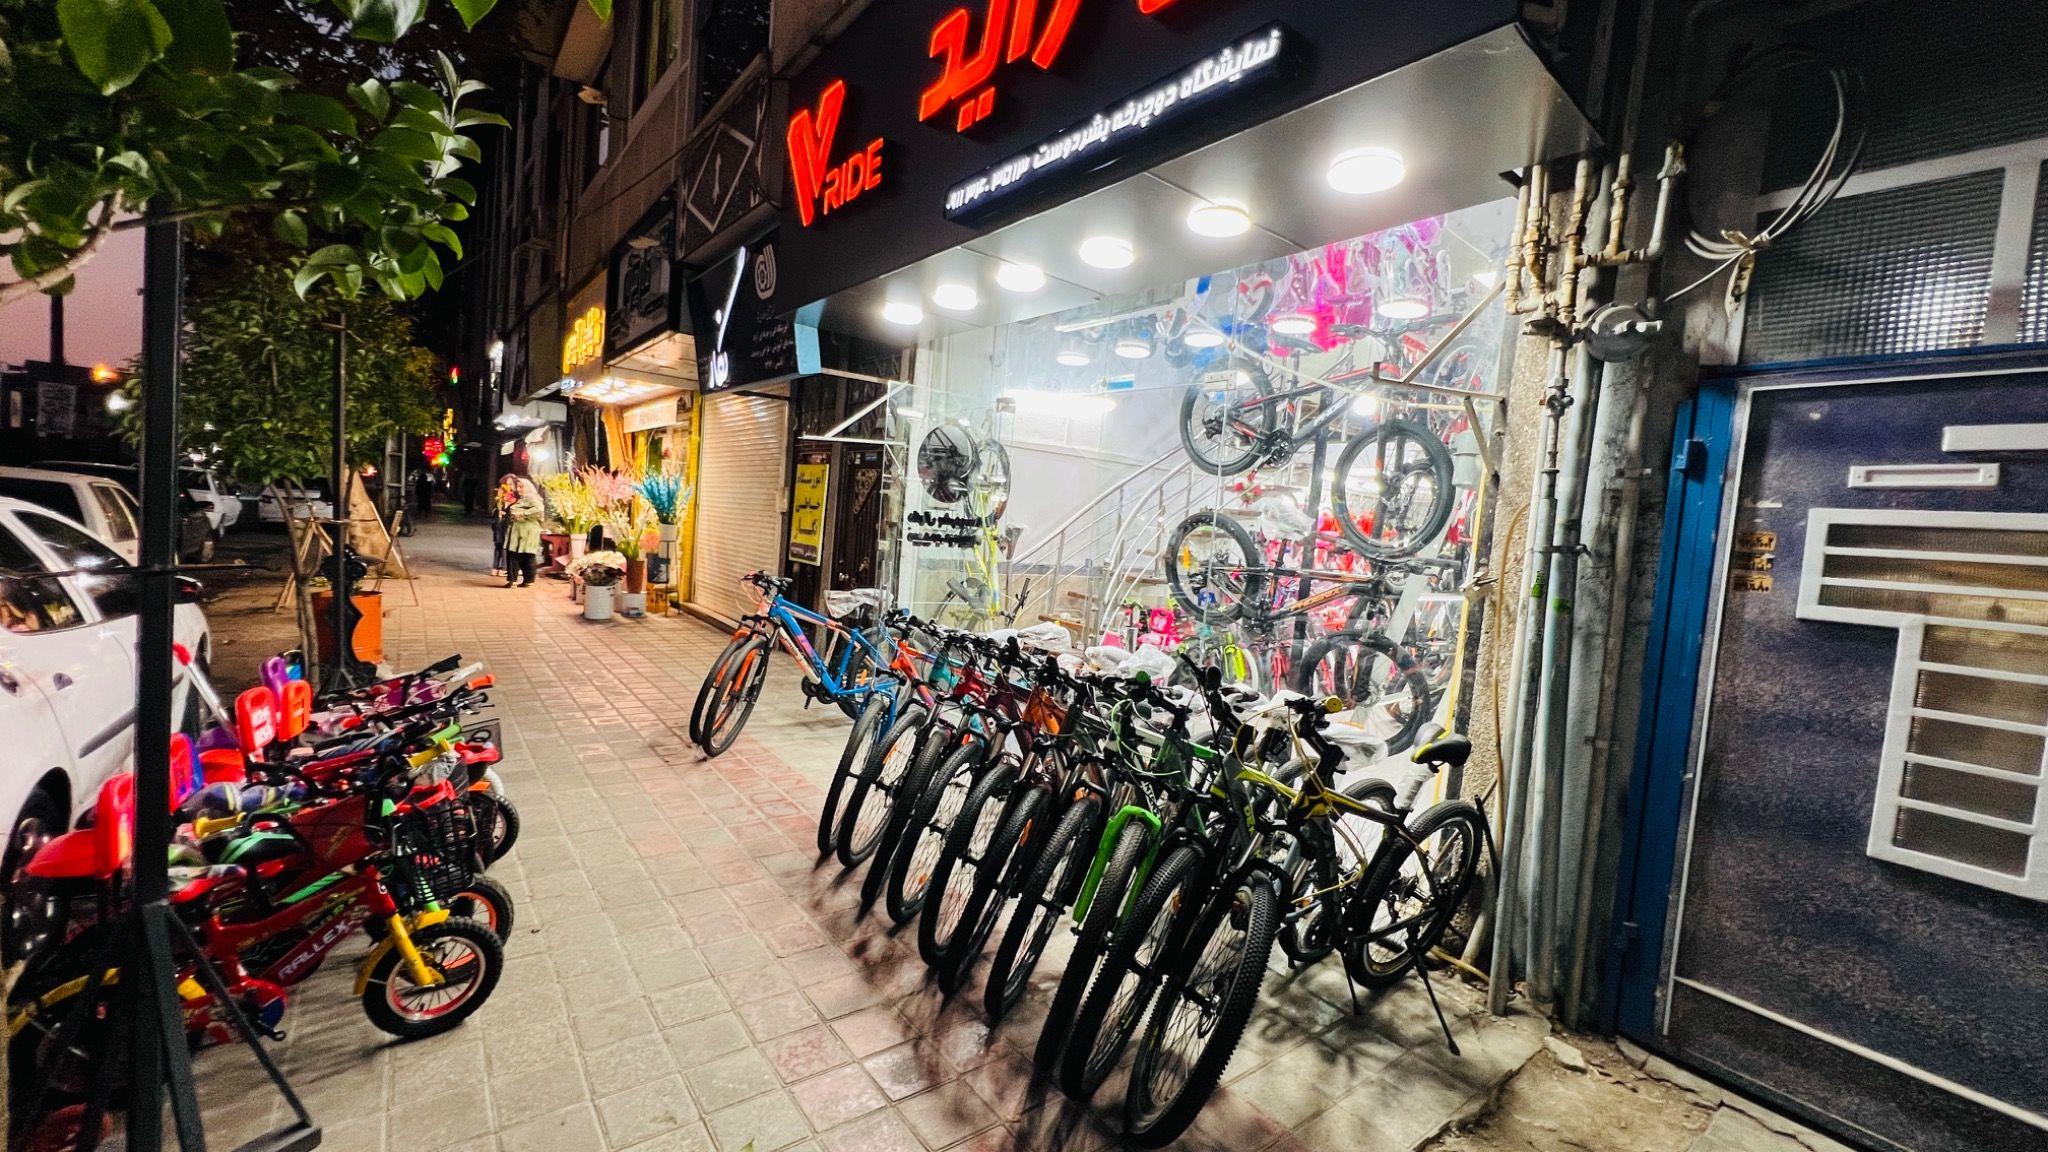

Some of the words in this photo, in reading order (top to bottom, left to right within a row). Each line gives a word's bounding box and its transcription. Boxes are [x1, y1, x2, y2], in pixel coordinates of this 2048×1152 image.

[1180, 29, 1280, 99] نمایشگاه
[1111, 84, 1178, 132] دوچرخه
[823, 137, 885, 216] RIDE
